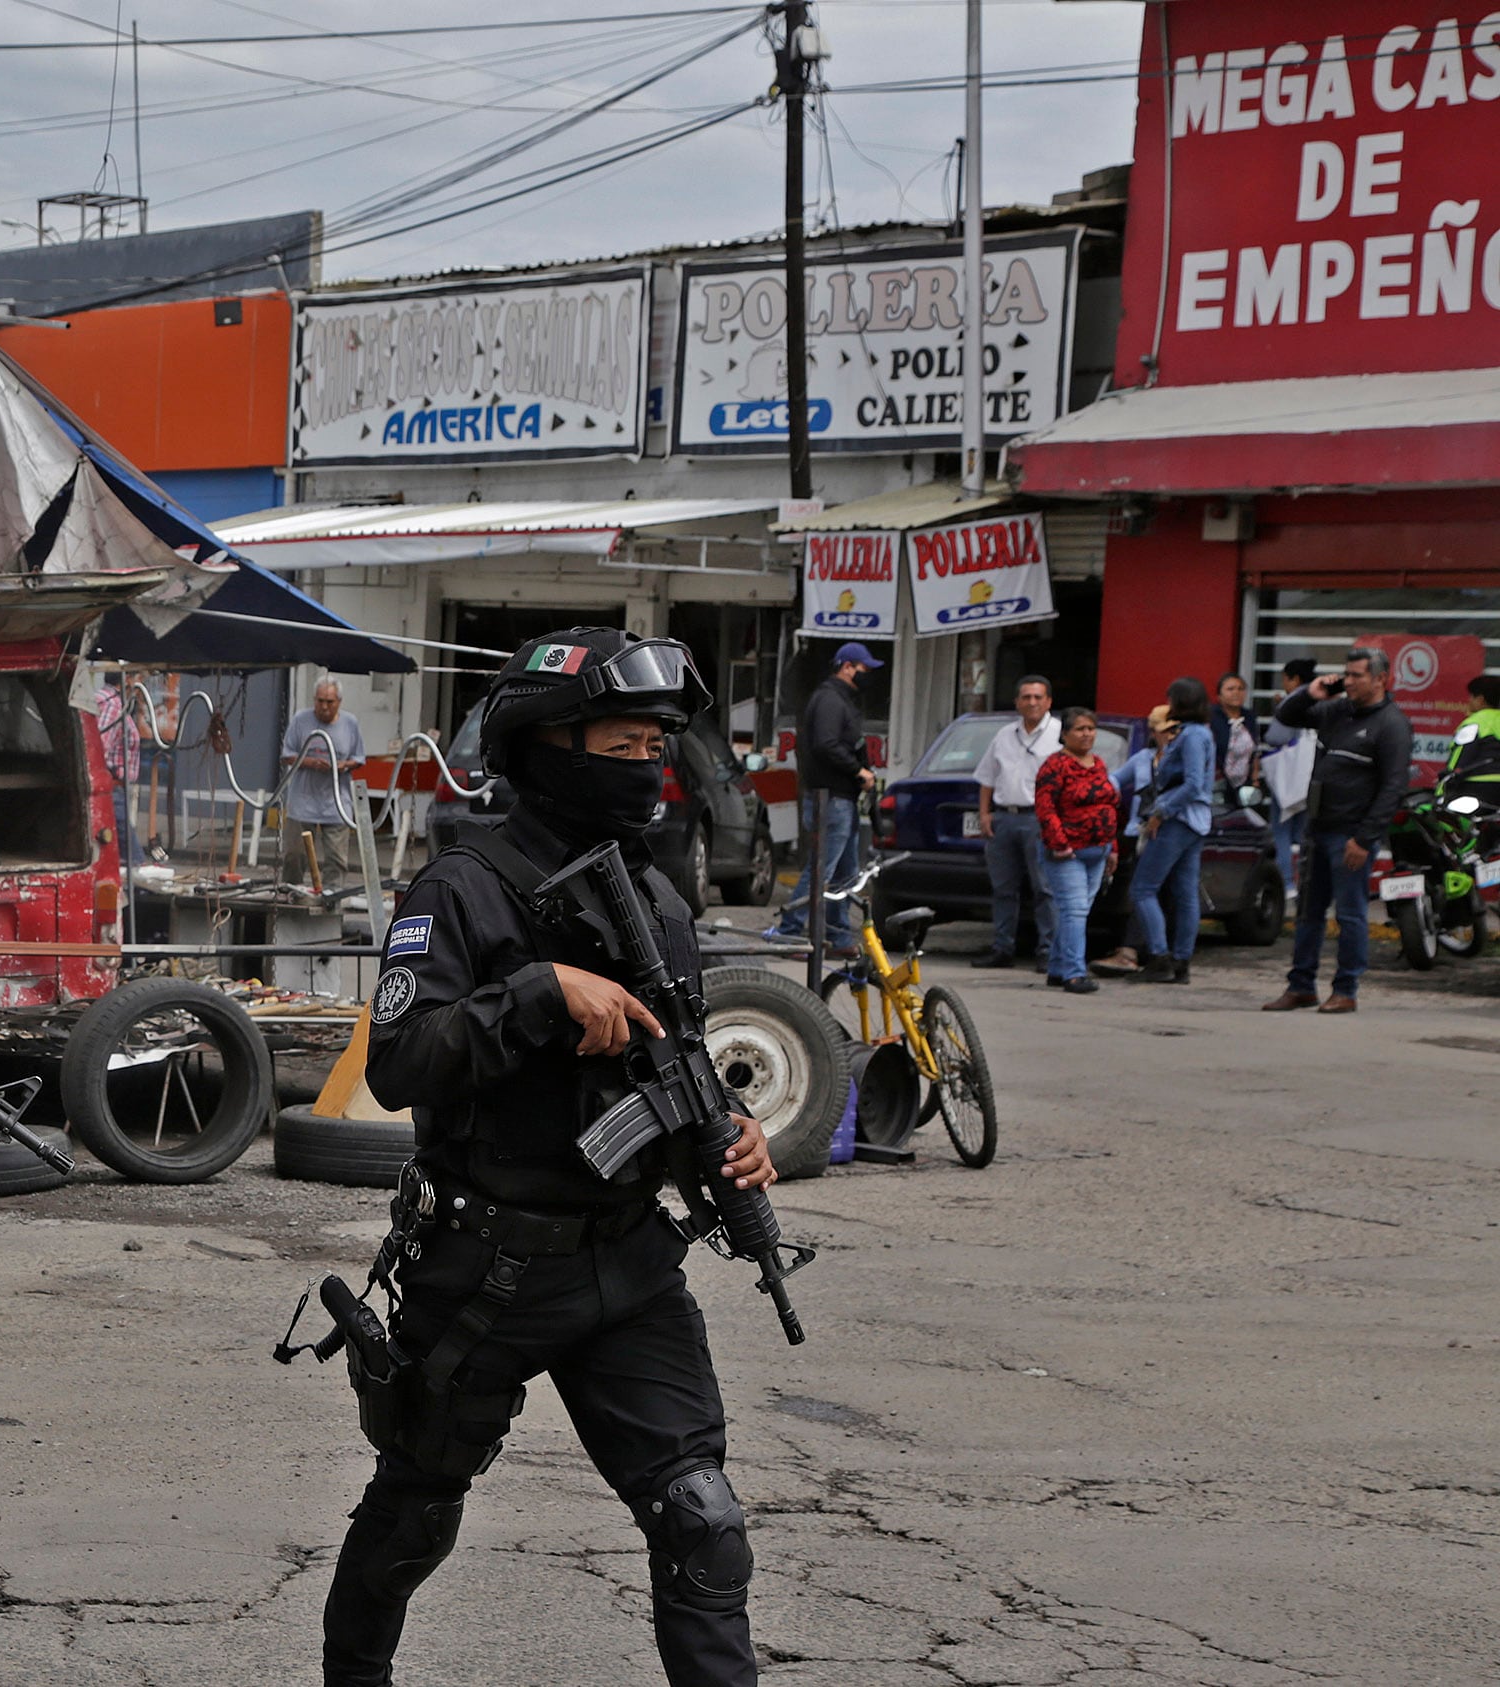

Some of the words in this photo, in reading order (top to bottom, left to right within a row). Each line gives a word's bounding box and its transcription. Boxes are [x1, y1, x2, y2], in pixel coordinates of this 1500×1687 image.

[1171, 35, 1355, 138] MEGA
[1296, 131, 1404, 222] DE
[308, 313, 392, 430] CHILES
[395, 306, 476, 402] SECOS
[479, 303, 503, 393] Y
[502, 291, 633, 415] SEMILLAS
[383, 402, 542, 446] AMERICA
[856, 390, 1032, 428] CALIETE
[808, 535, 894, 582] POLLERIA
[913, 518, 1041, 580] POLLERIA
[822, 612, 873, 628] Lety
[947, 597, 1021, 622] Lety
[390, 926, 427, 941] FUERZAS
[376, 1010, 394, 1020] UTR
